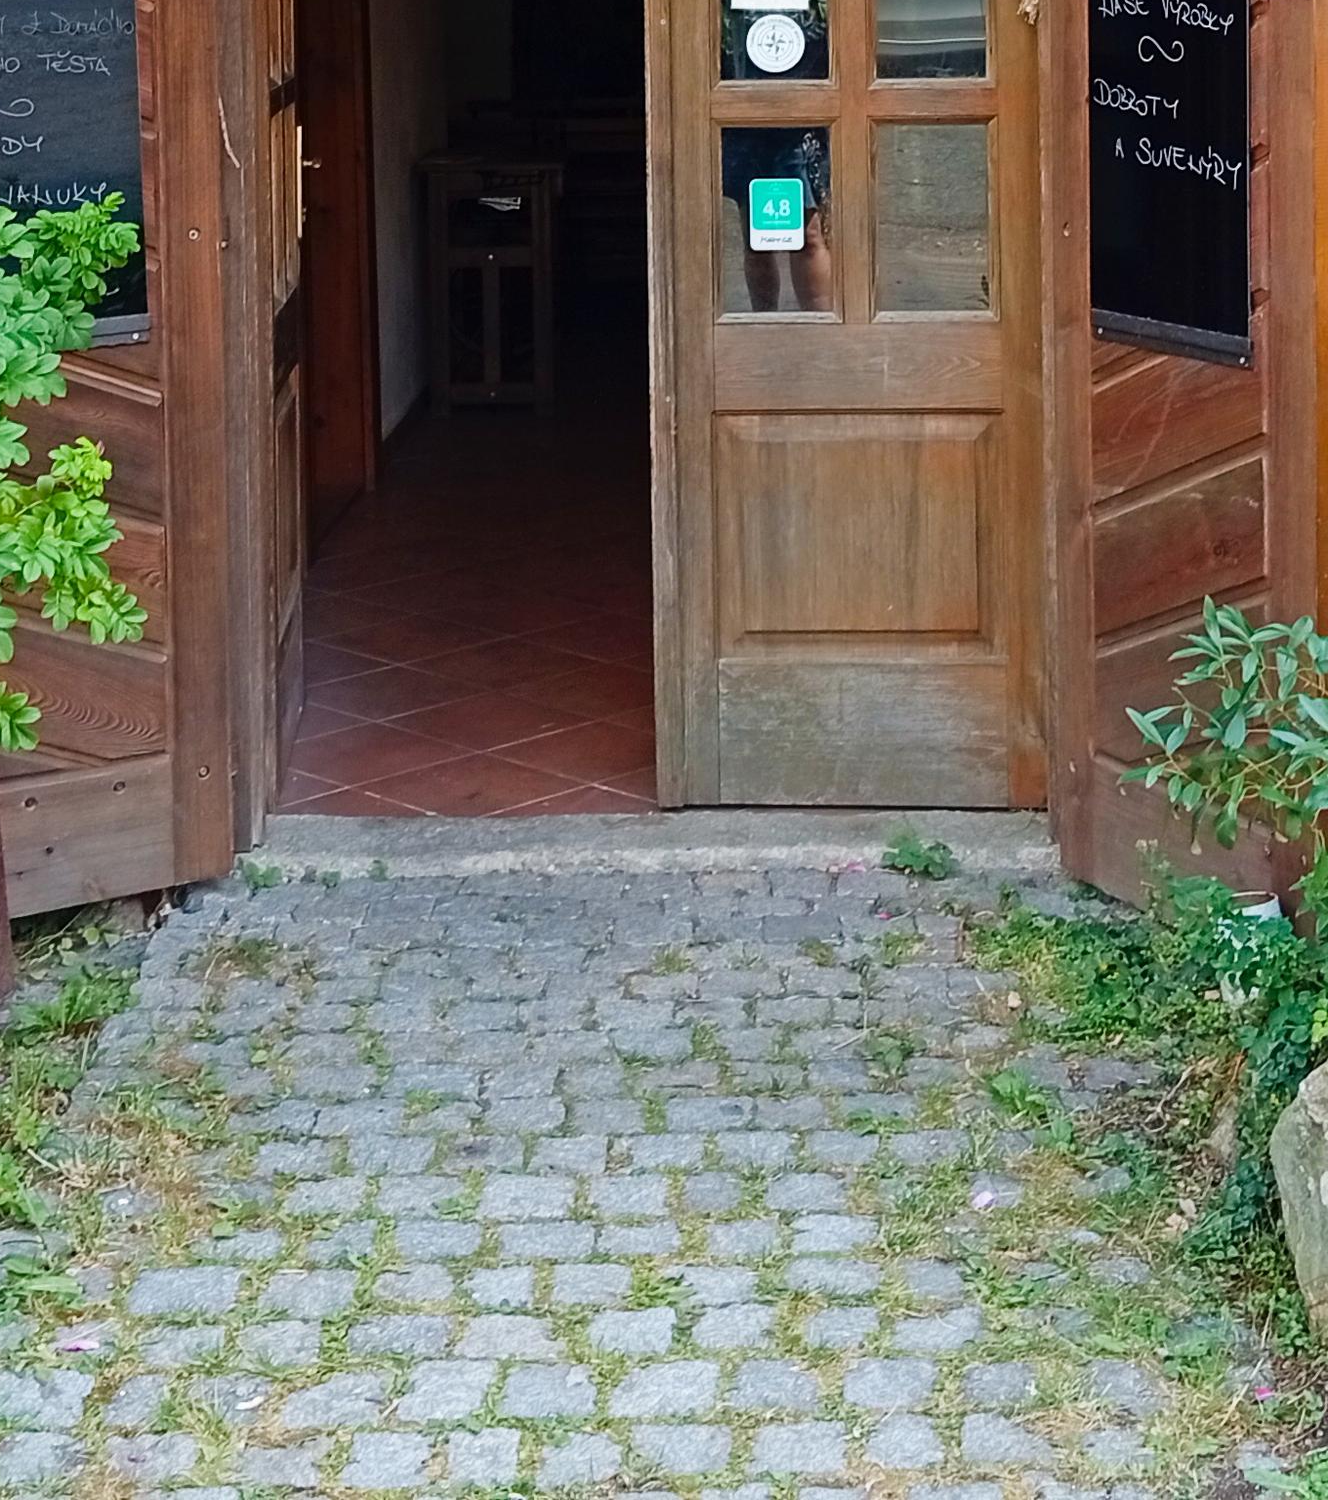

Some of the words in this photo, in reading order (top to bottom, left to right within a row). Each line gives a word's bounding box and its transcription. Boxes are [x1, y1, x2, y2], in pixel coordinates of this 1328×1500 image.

[36, 50, 111, 77] TĚSTA
[1093, 78, 1179, 120] DOBROTY
[1115, 137, 1125, 159] A
[1135, 137, 1242, 190] SUVENÝRY
[762, 198, 791, 220] 4,8
